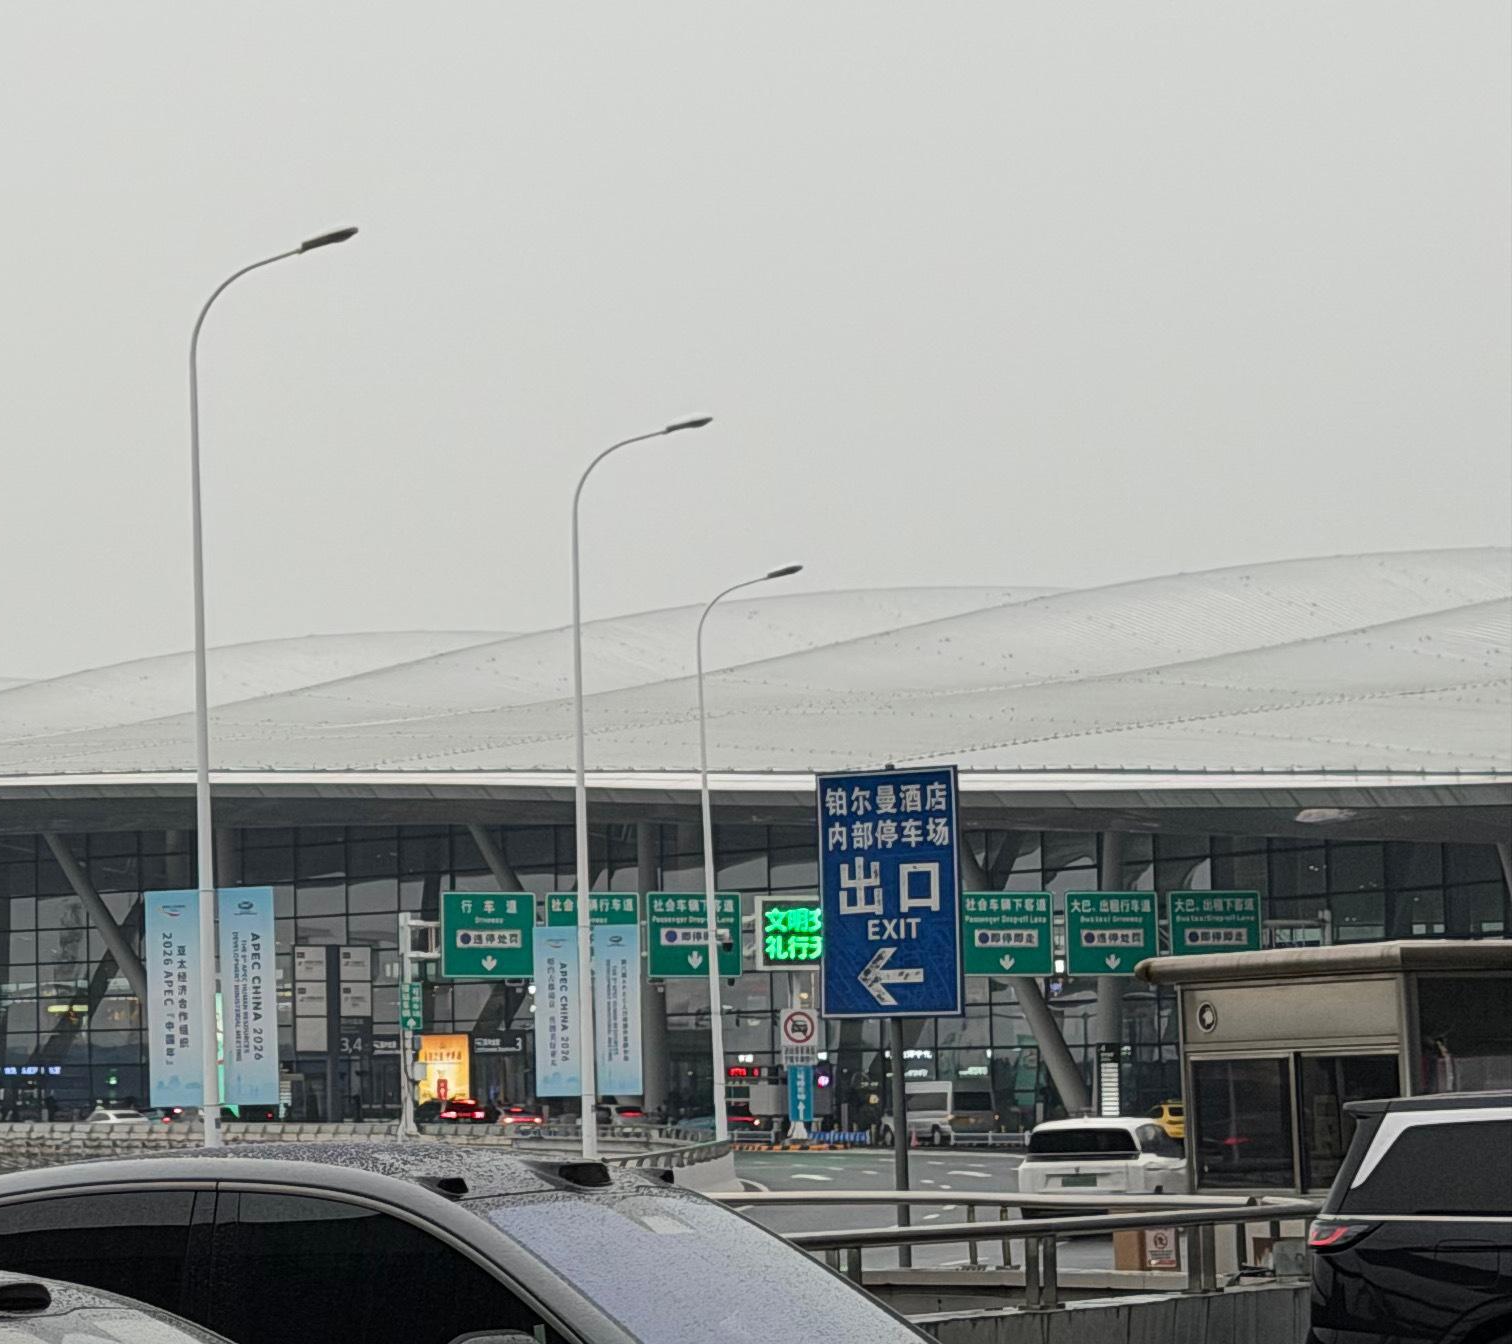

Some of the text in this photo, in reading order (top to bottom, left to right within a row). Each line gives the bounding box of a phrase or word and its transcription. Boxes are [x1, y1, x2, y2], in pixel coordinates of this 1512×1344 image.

[825, 781, 947, 816] 铂尔曼酒店
[828, 817, 950, 852] 内部停车场
[839, 856, 941, 916] 出口
[965, 898, 1047, 912] 社会车辆下客道
[867, 917, 922, 941] EXIT
[162, 932, 174, 966] 2026
[164, 970, 174, 1007] APEC
[251, 932, 264, 1061] APEC CHINA 2026
